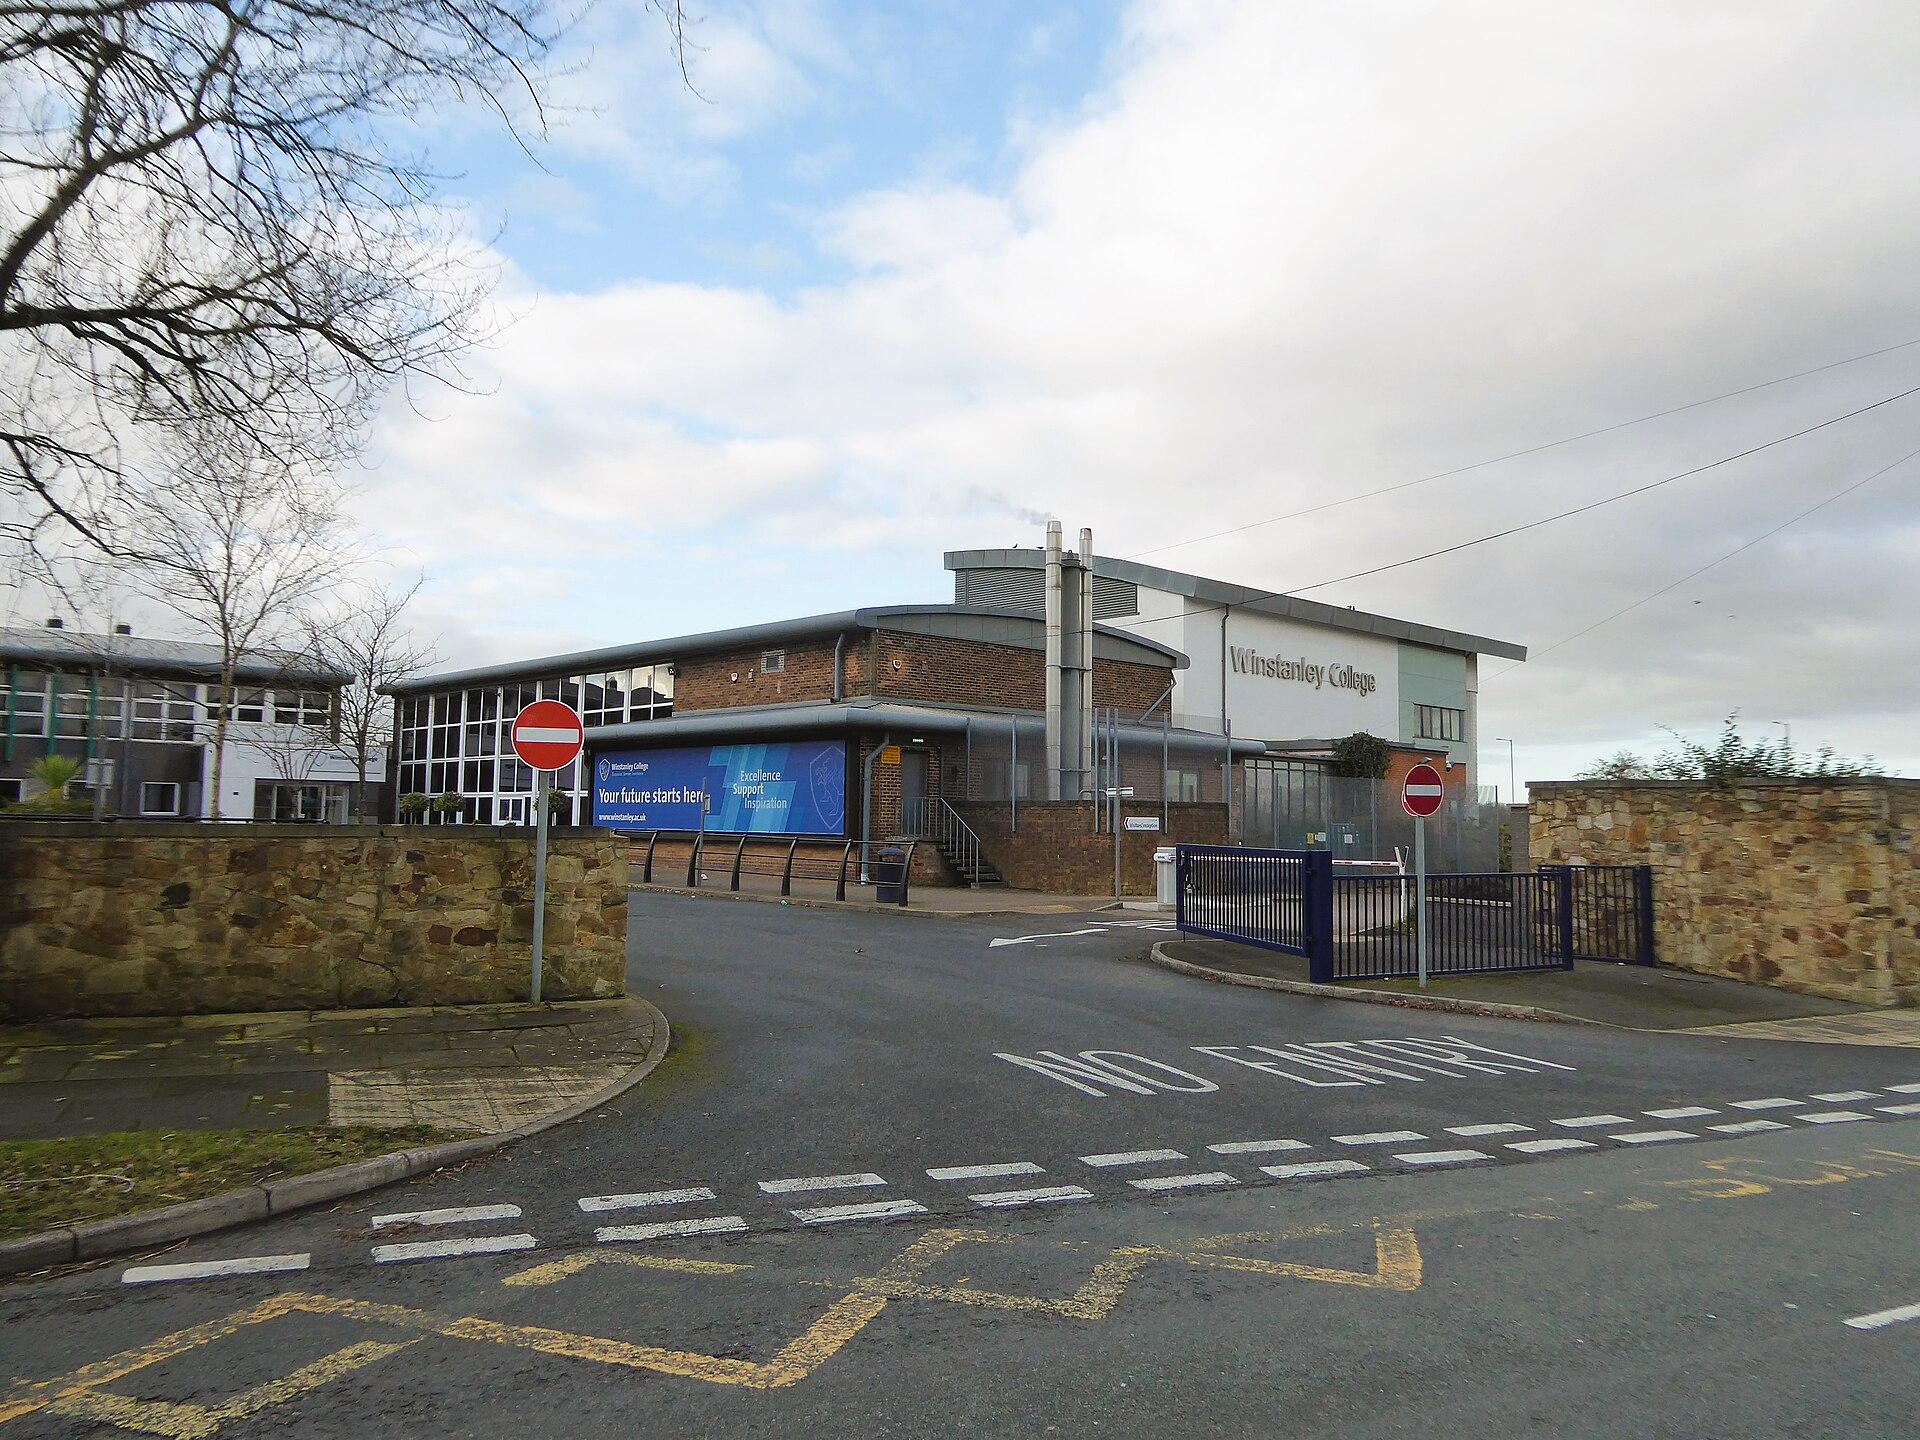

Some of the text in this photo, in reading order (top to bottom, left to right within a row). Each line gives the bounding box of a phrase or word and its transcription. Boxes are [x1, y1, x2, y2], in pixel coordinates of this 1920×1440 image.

[1230, 645, 1376, 697] Winstanley College
[611, 762, 649, 772] Winstanley College
[740, 769, 781, 782] Excellence
[598, 788, 619, 804] Your
[621, 787, 651, 804] future
[652, 787, 681, 803] starts
[732, 783, 764, 798] Support
[744, 797, 788, 812] Inspiration
[992, 1035, 1577, 1098] NO ENTRY
